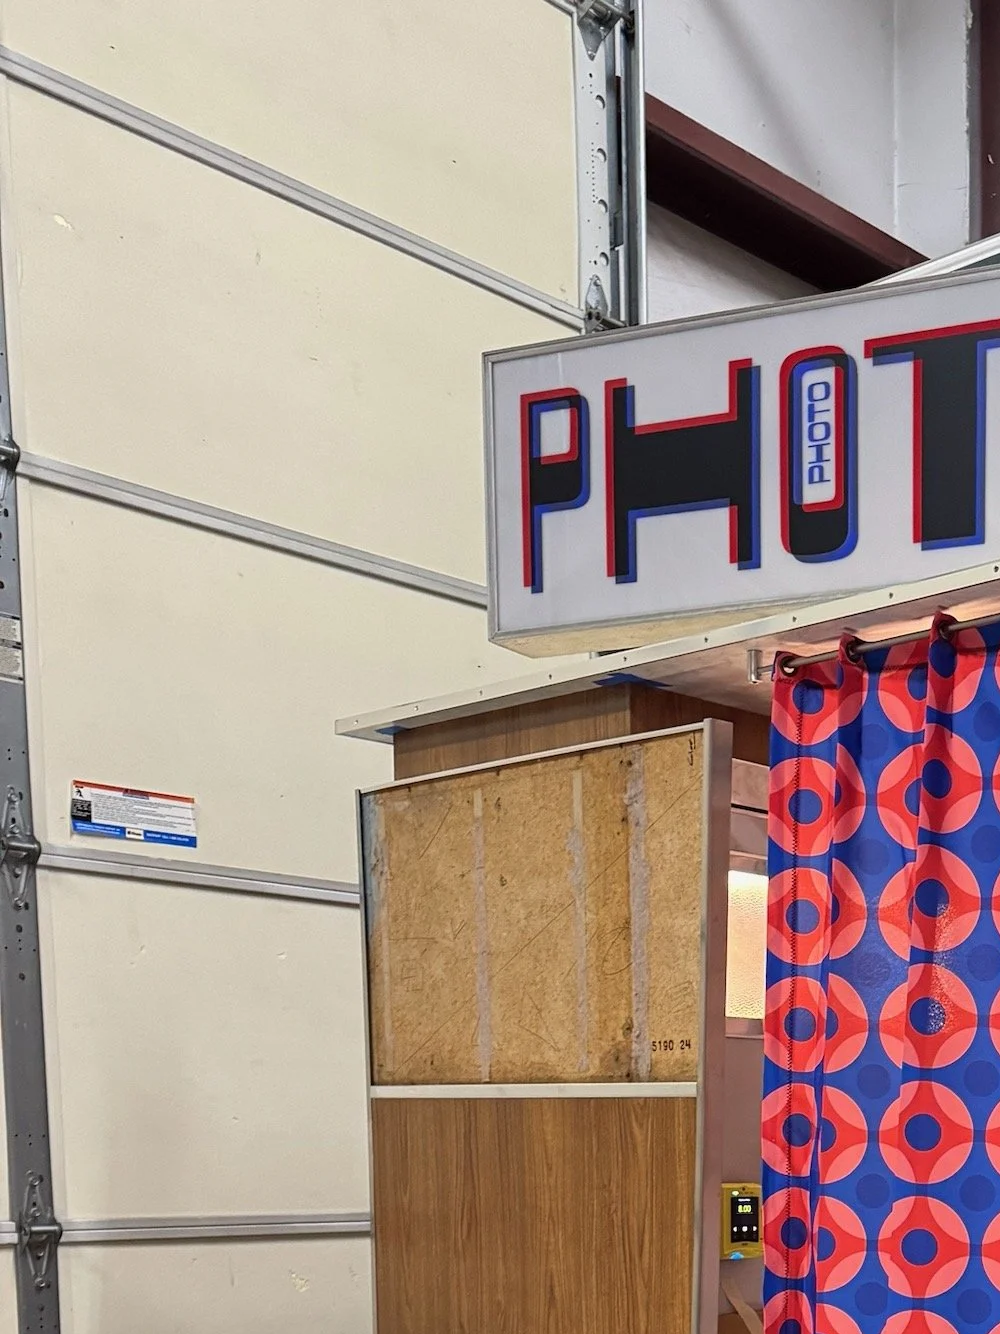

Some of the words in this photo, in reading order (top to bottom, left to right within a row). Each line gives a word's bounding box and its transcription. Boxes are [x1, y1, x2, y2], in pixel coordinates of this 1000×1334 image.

[806, 380, 833, 485] PHOTO
[652, 1040, 674, 1051] 5190
[680, 1039, 691, 1050] 24
